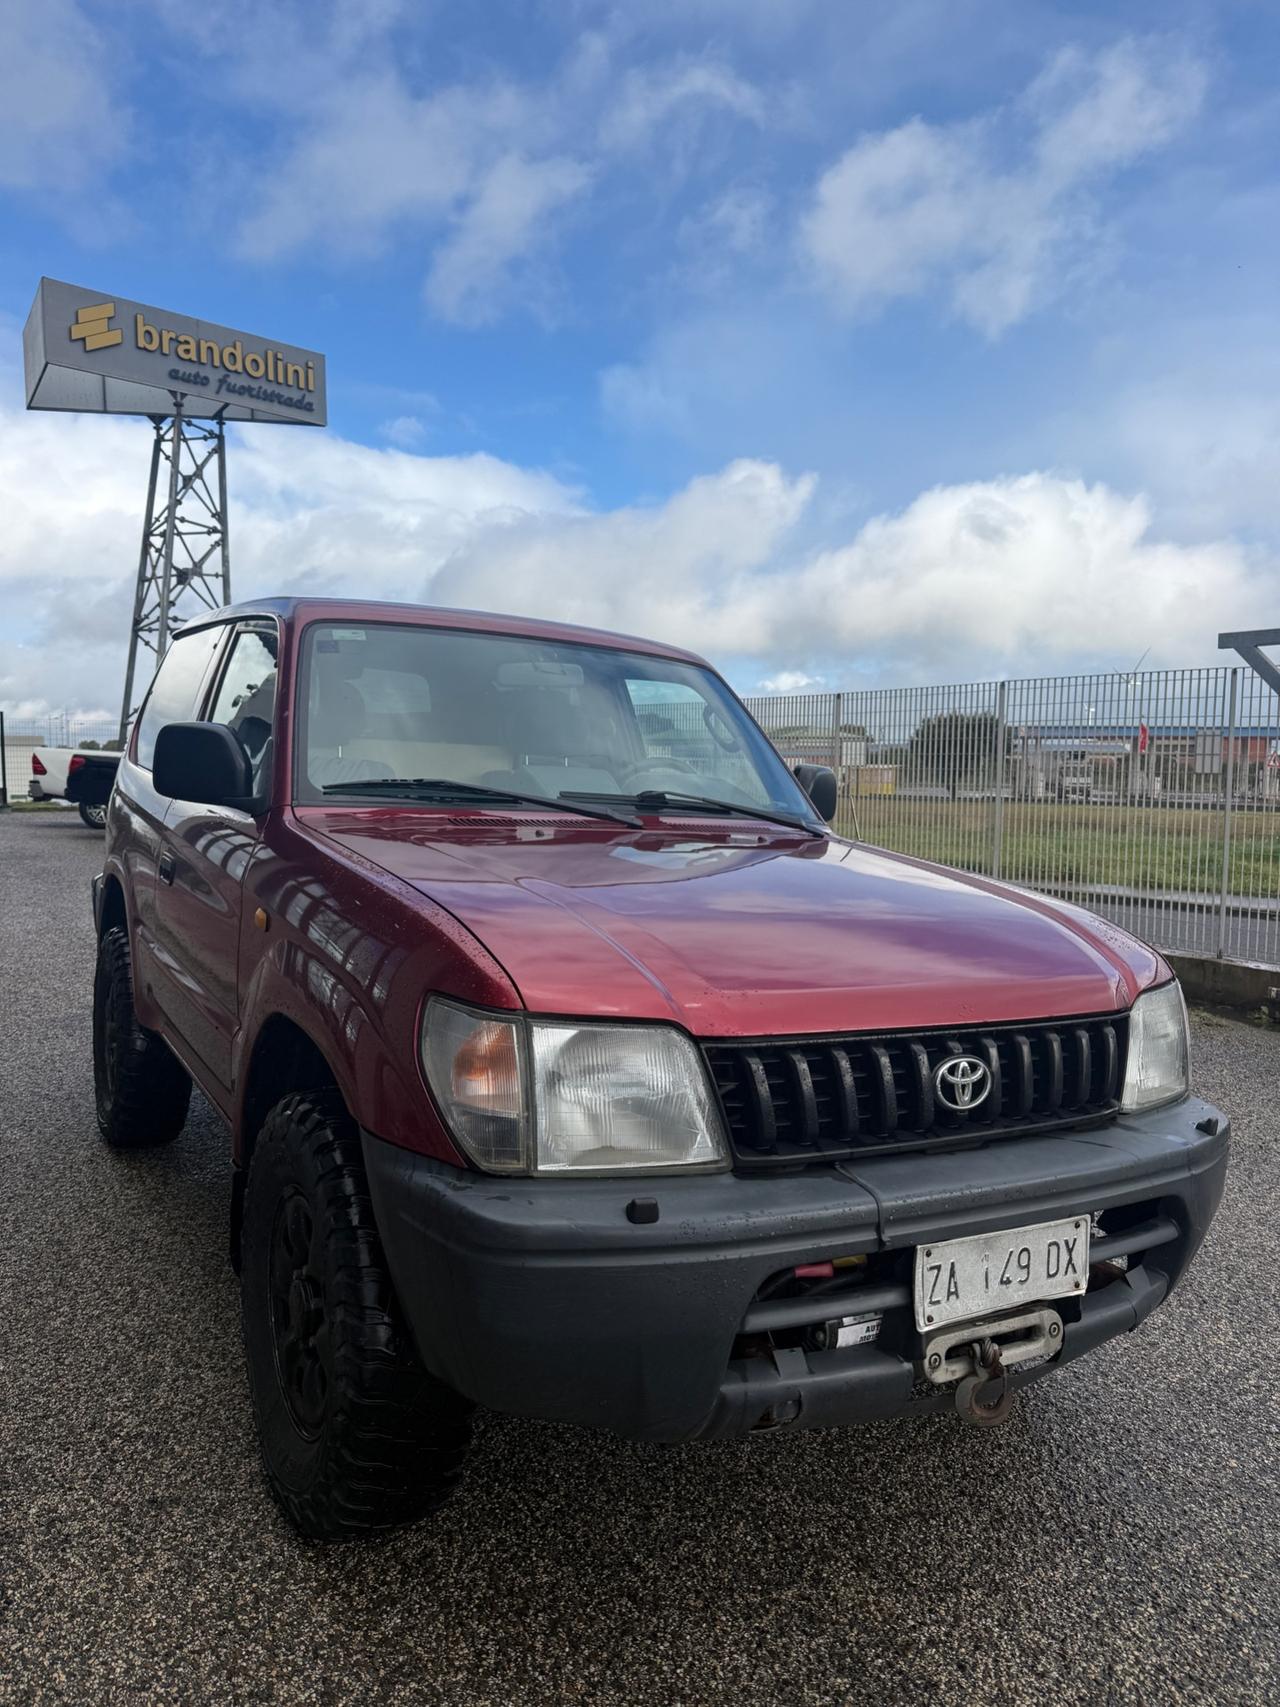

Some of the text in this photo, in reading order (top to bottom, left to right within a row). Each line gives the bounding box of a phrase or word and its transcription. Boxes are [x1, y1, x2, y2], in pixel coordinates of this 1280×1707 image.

[135, 313, 315, 392] brandolini
[168, 368, 315, 412] auto fuoristrada
[927, 1236, 1078, 1305] ZA 149 DX
